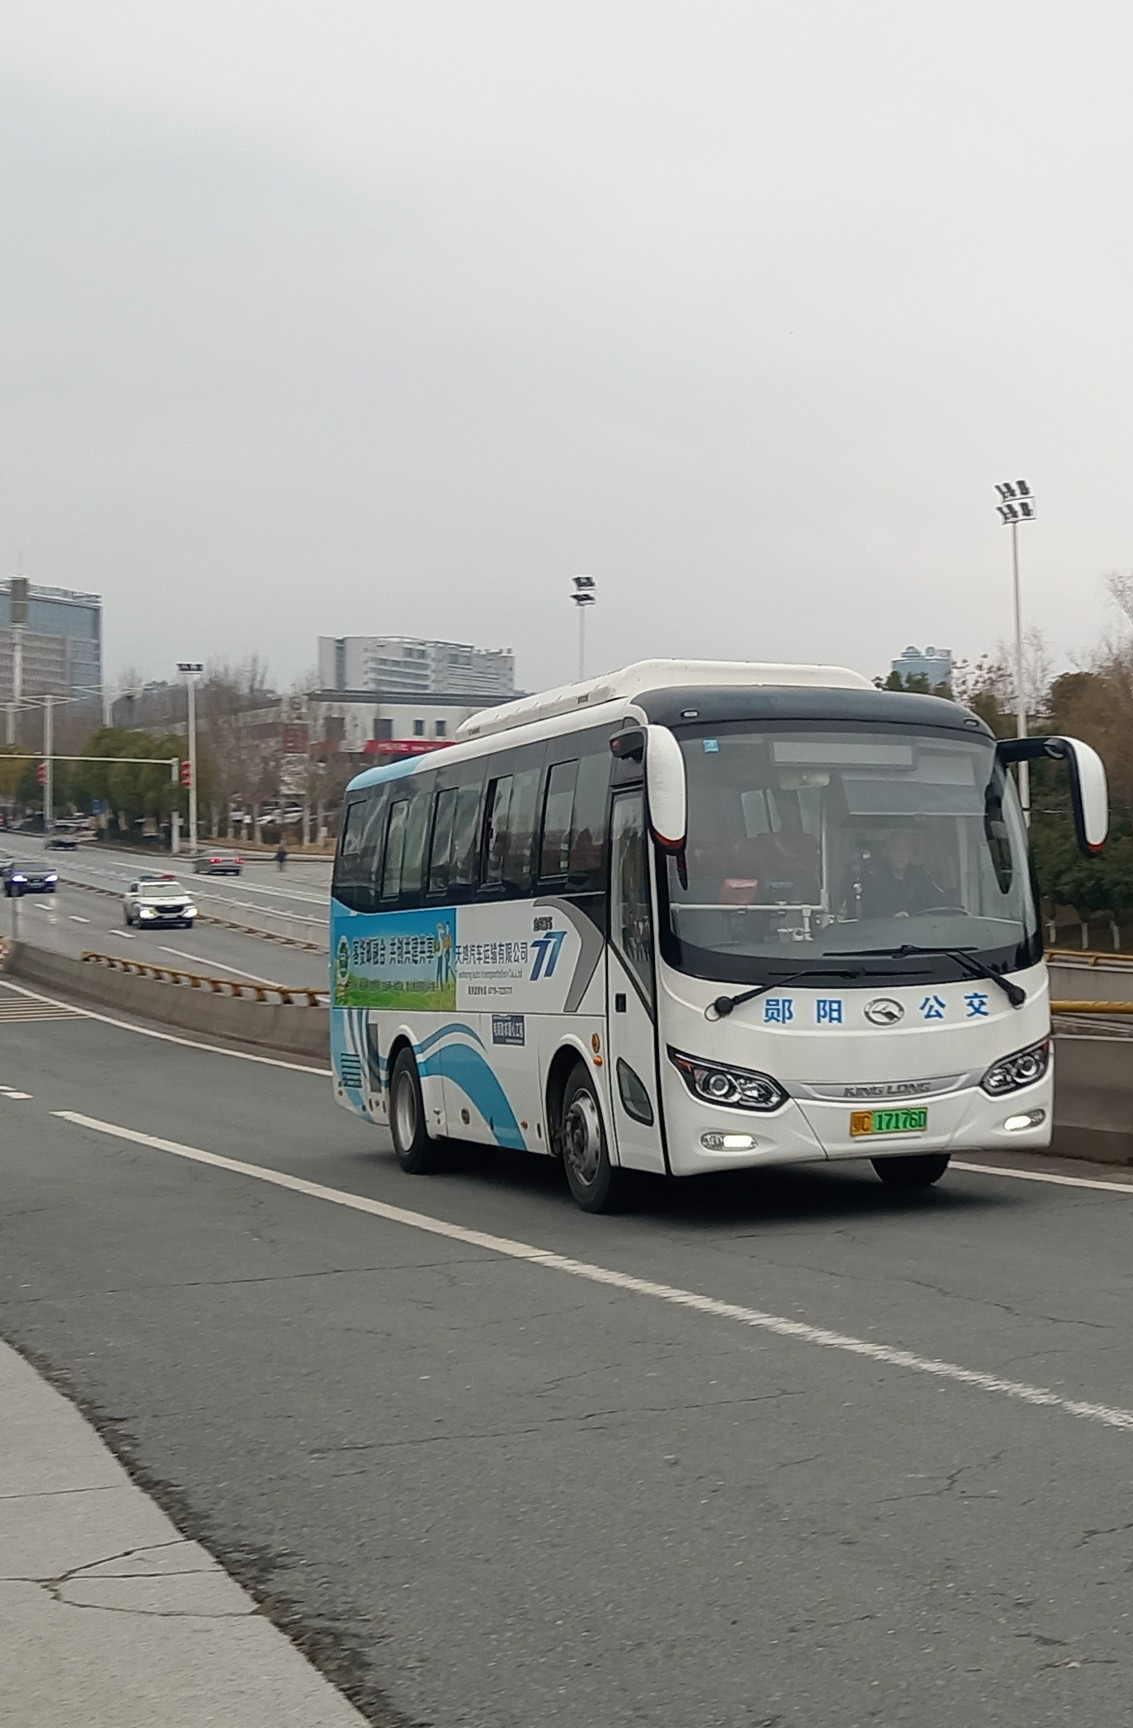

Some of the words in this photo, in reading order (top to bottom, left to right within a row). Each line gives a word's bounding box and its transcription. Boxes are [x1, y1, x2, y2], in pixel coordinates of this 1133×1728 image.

[764, 998, 843, 1024] 郧阳
[919, 992, 990, 1019] 公交
[844, 1085, 886, 1098] KING
[886, 1081, 932, 1096] LONG
